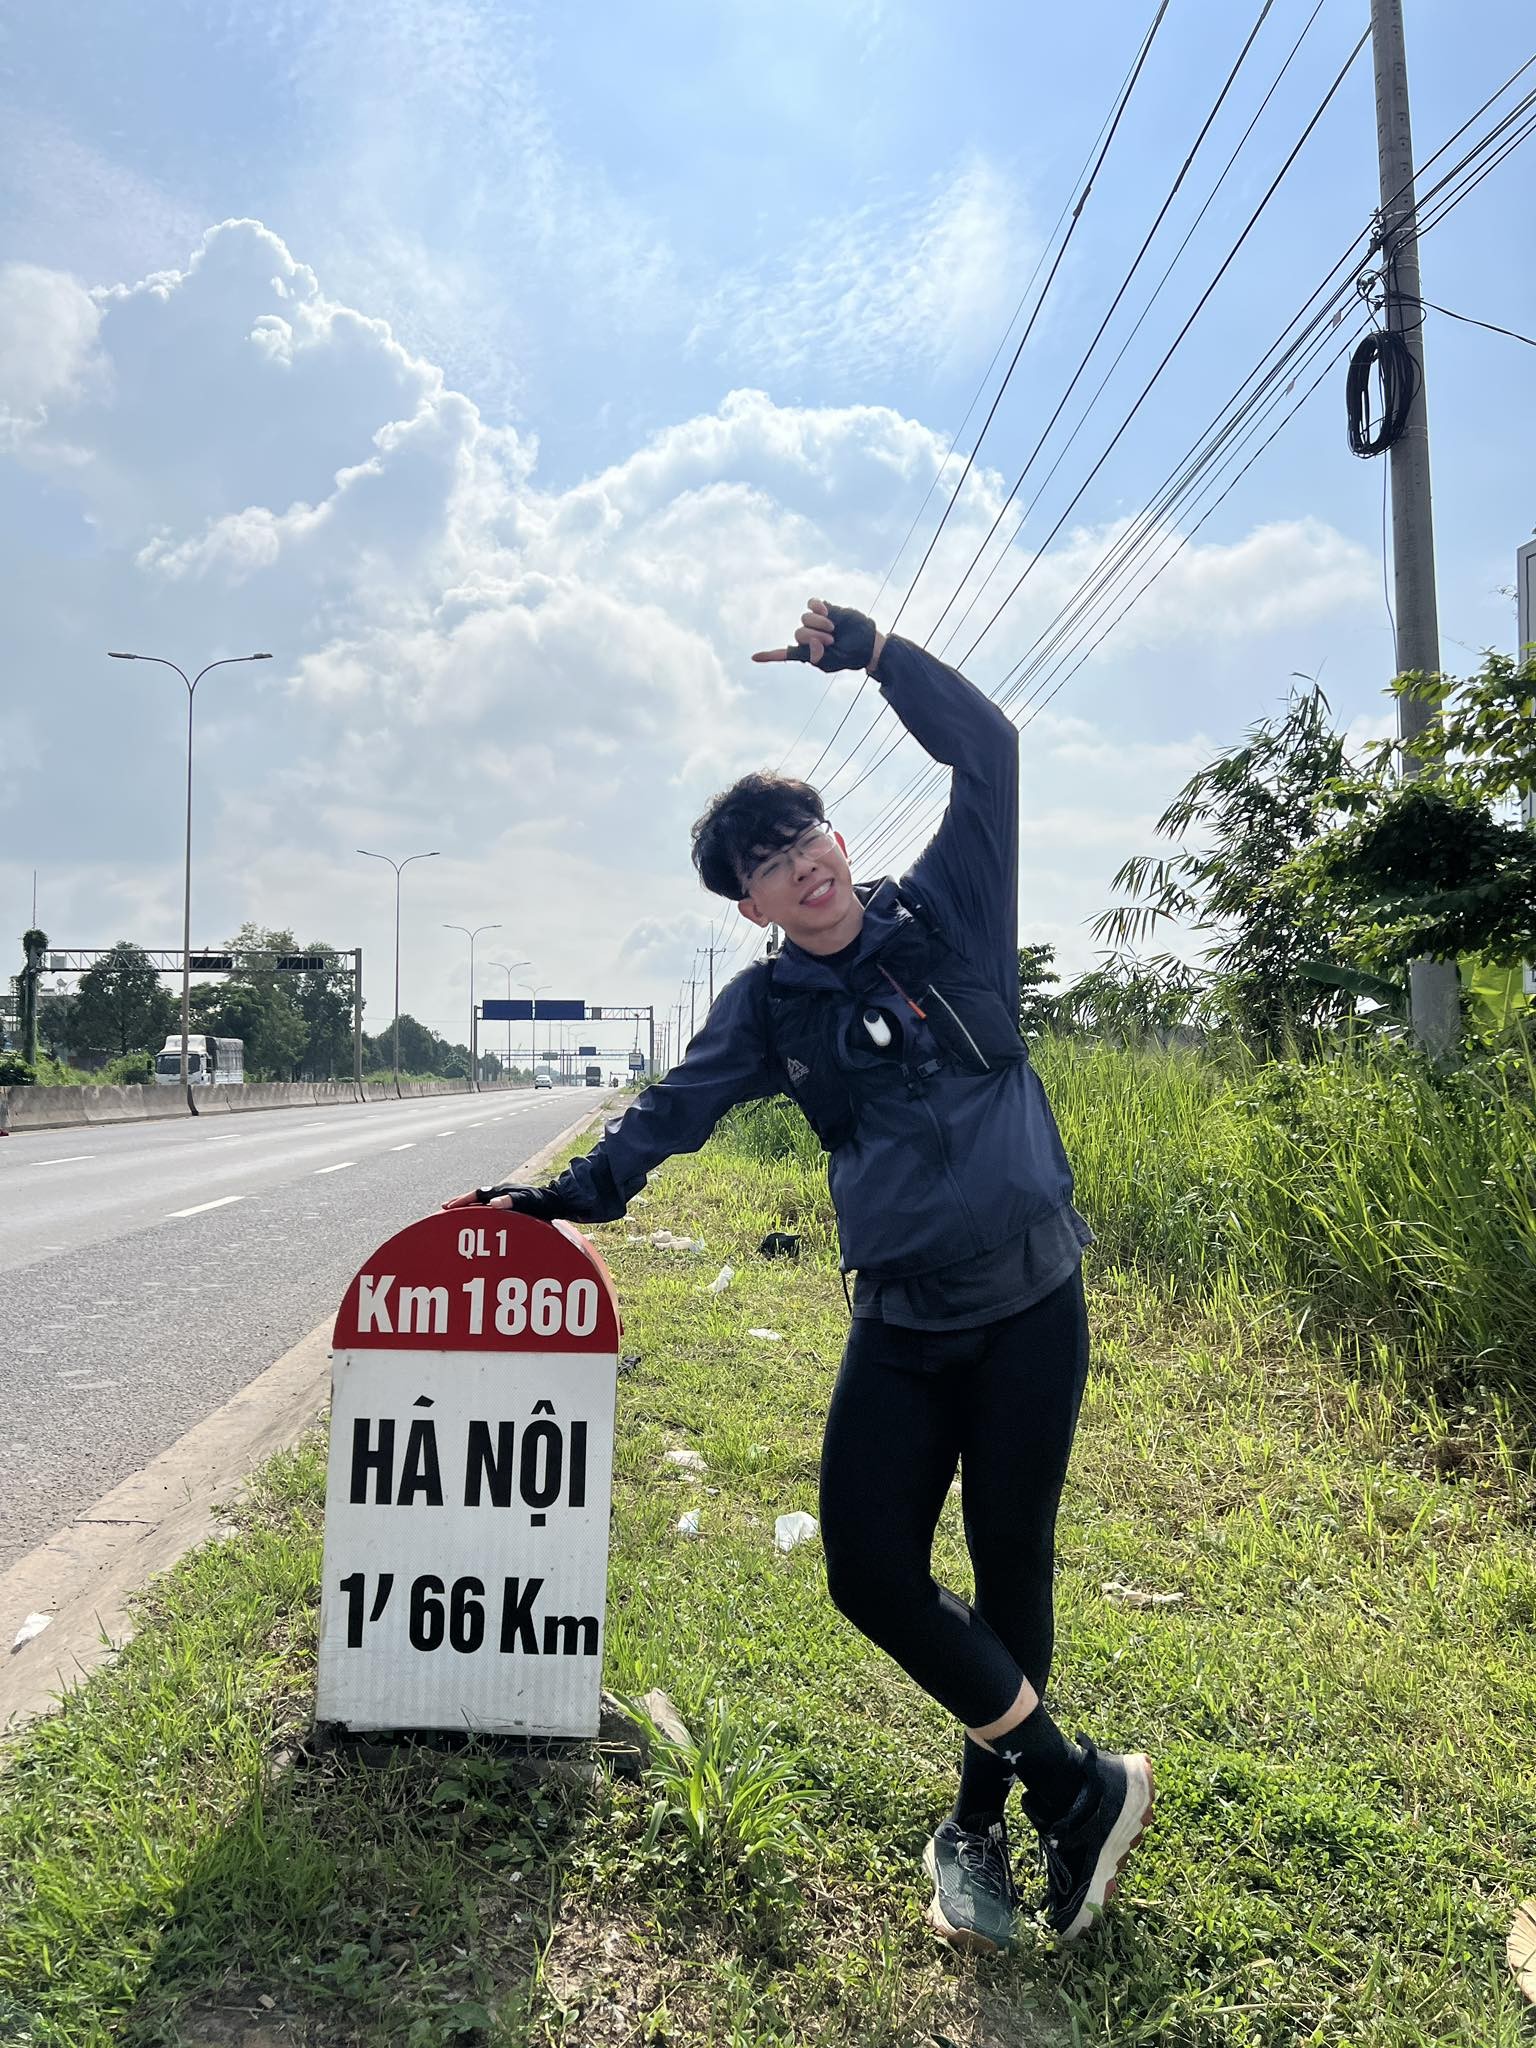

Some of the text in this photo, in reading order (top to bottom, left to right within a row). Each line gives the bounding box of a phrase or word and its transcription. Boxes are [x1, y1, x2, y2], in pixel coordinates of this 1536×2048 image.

[457, 1228, 508, 1260] QL 1
[357, 1274, 599, 1337] Km 1860
[463, 1399, 588, 1527] NỘI
[499, 1576, 600, 1657] Km
